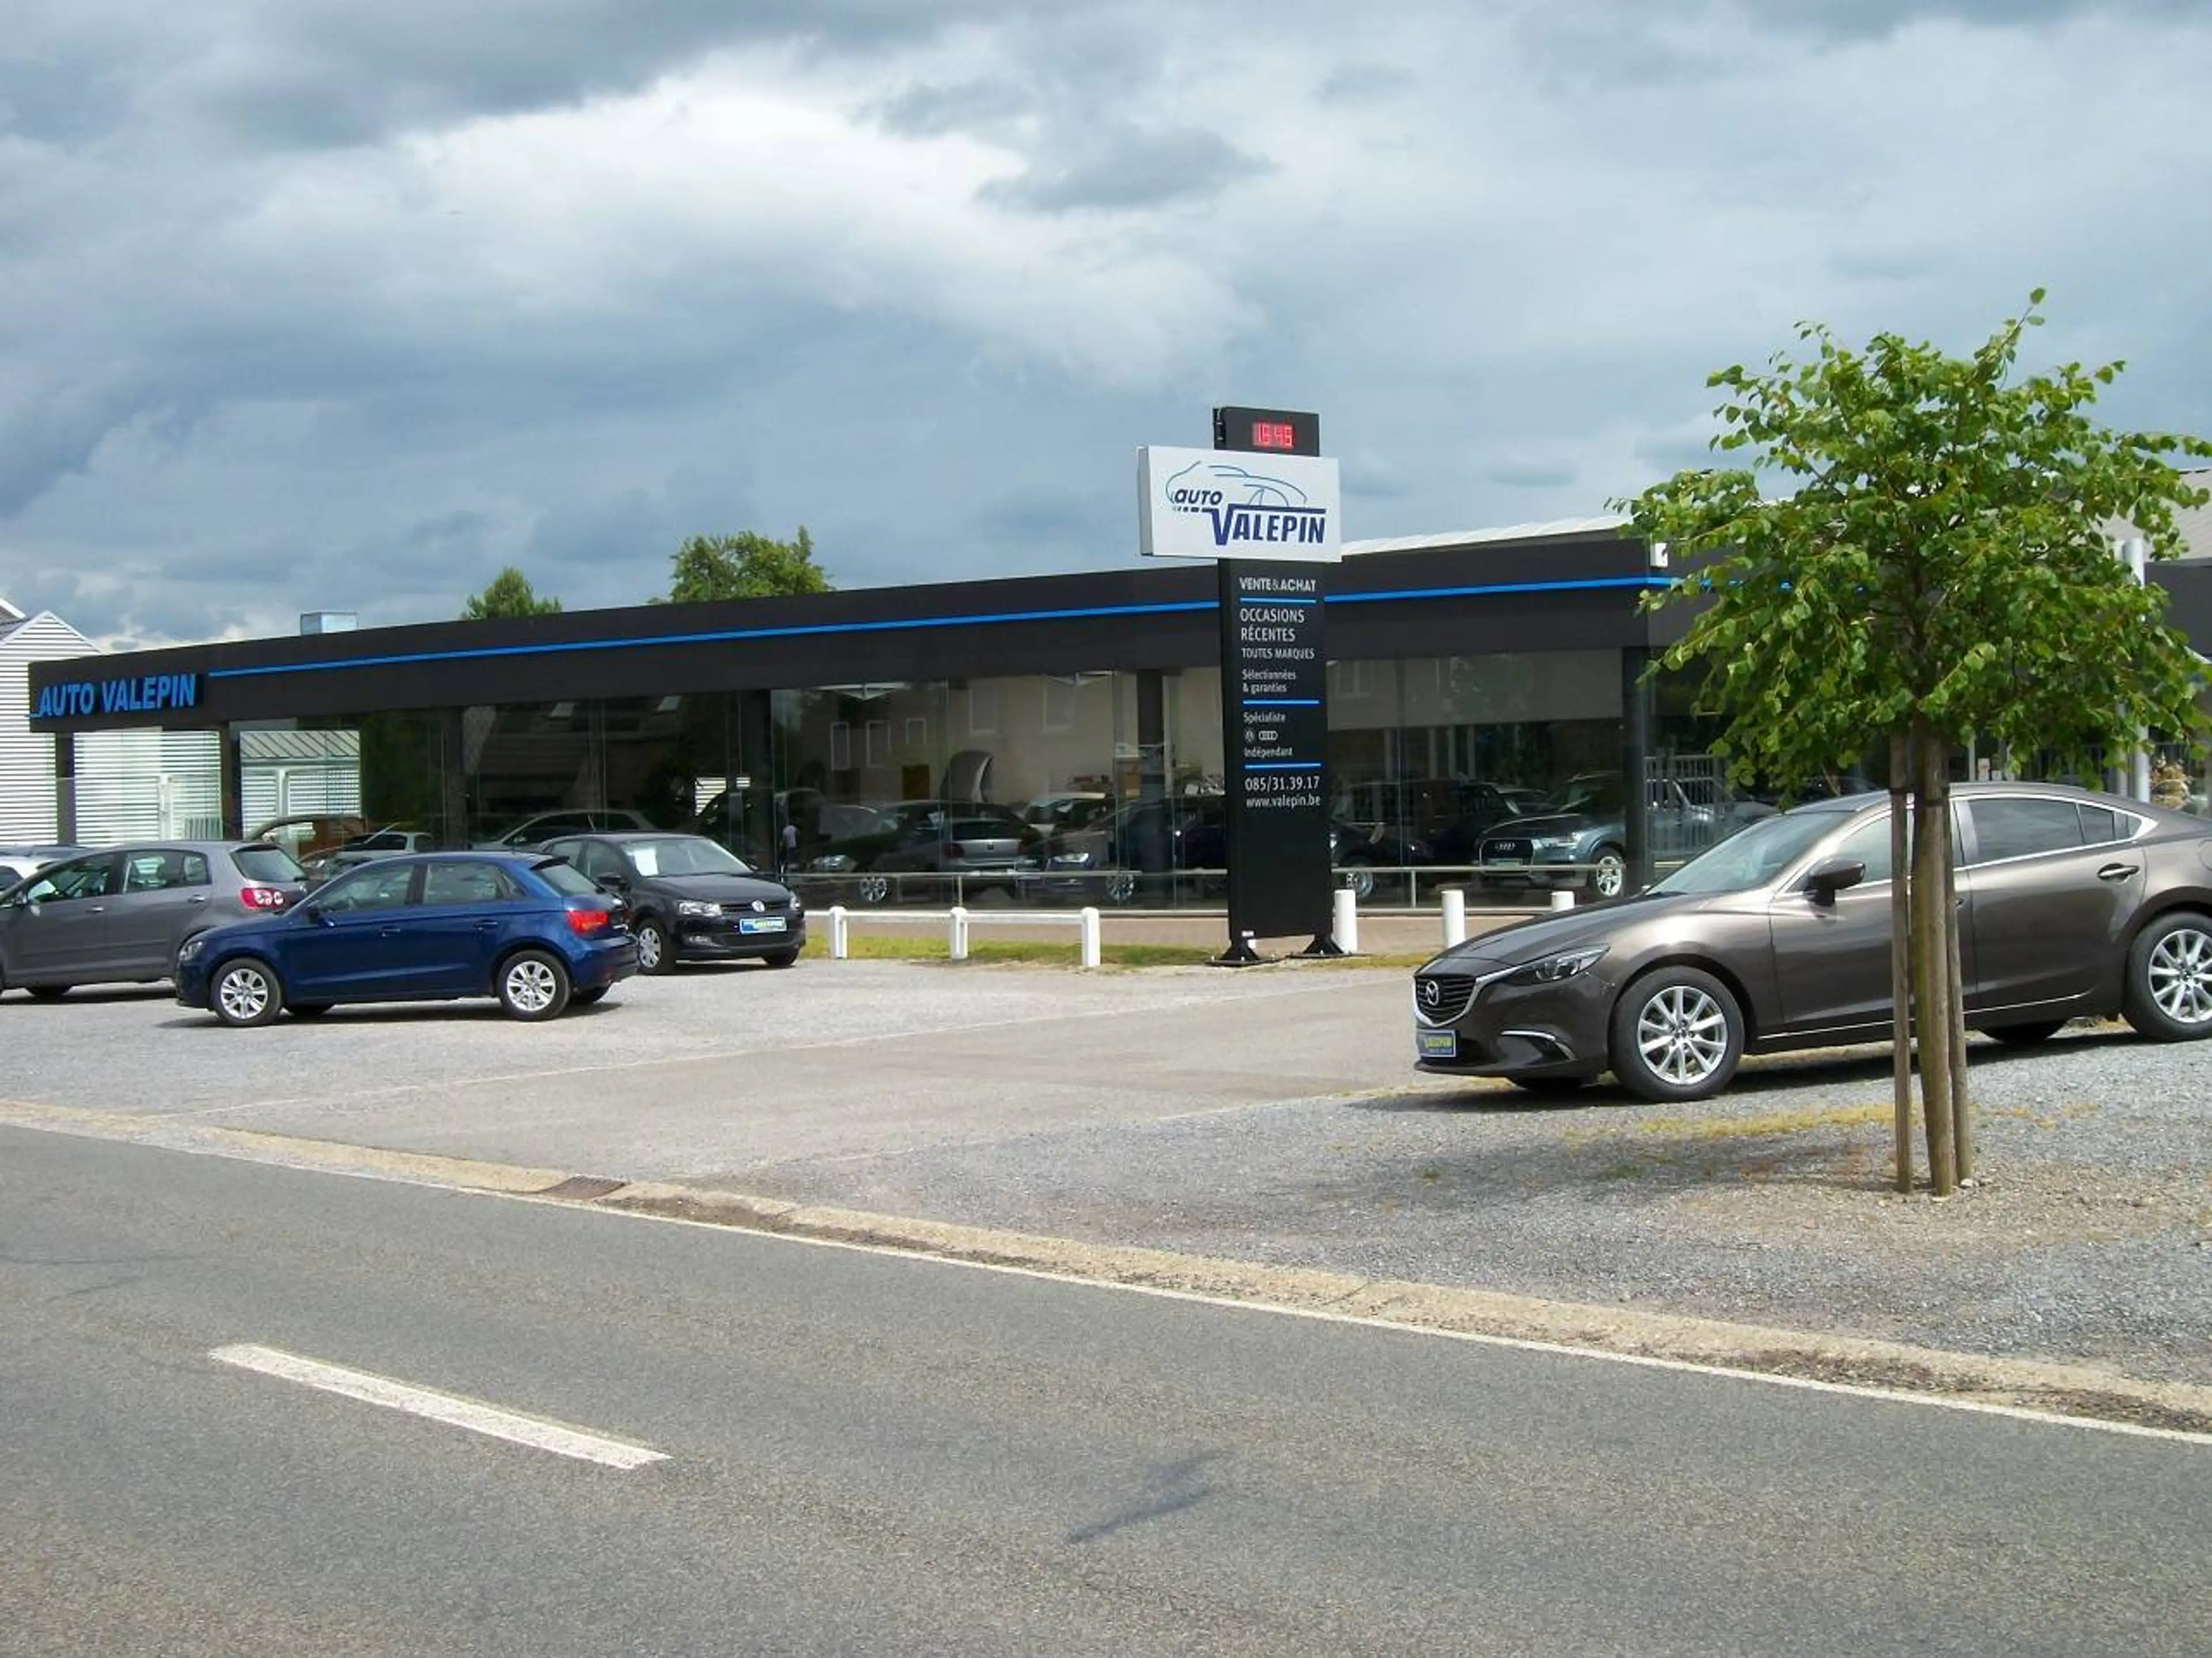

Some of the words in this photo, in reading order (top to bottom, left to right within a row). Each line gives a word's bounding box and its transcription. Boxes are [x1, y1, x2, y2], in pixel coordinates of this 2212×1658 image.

[1211, 503, 1325, 545] VALEPIN
[1240, 609, 1304, 623] OCCASIONS
[1241, 624, 1296, 642] RÉCENTES
[1241, 648, 1272, 659] TOUTES
[1275, 648, 1315, 660] MARQUES
[39, 684, 94, 717] AUTO
[101, 674, 196, 712] VALEPIN
[1245, 776, 1320, 792] 085/31.39.17
[1246, 794, 1321, 809] www.valepin.be
